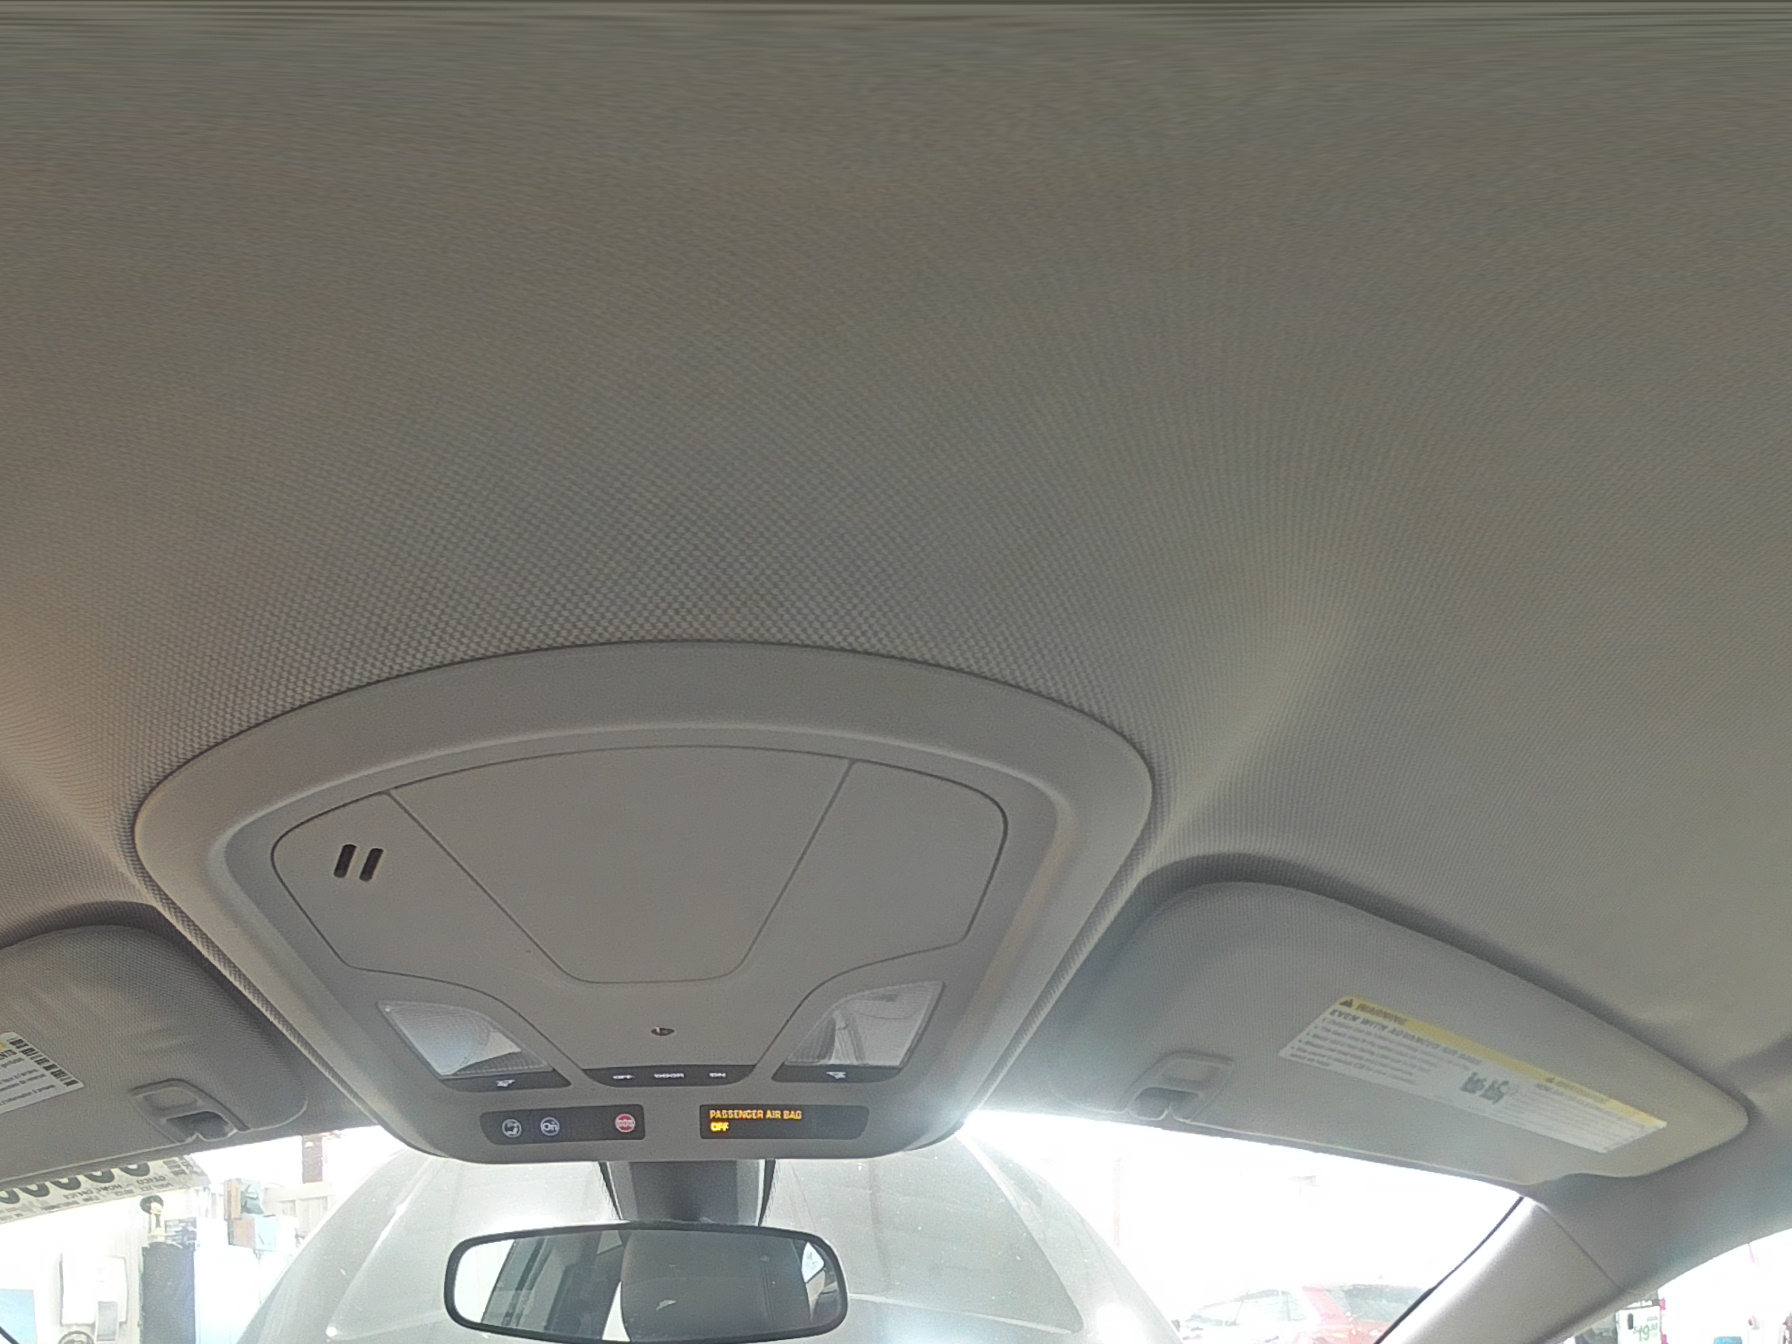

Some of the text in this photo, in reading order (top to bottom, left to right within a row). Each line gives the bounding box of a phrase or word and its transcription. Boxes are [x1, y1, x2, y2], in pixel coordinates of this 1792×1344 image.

[709, 1109, 802, 1120] PASSENGER AIR BAG
[710, 1121, 730, 1132] OFF
